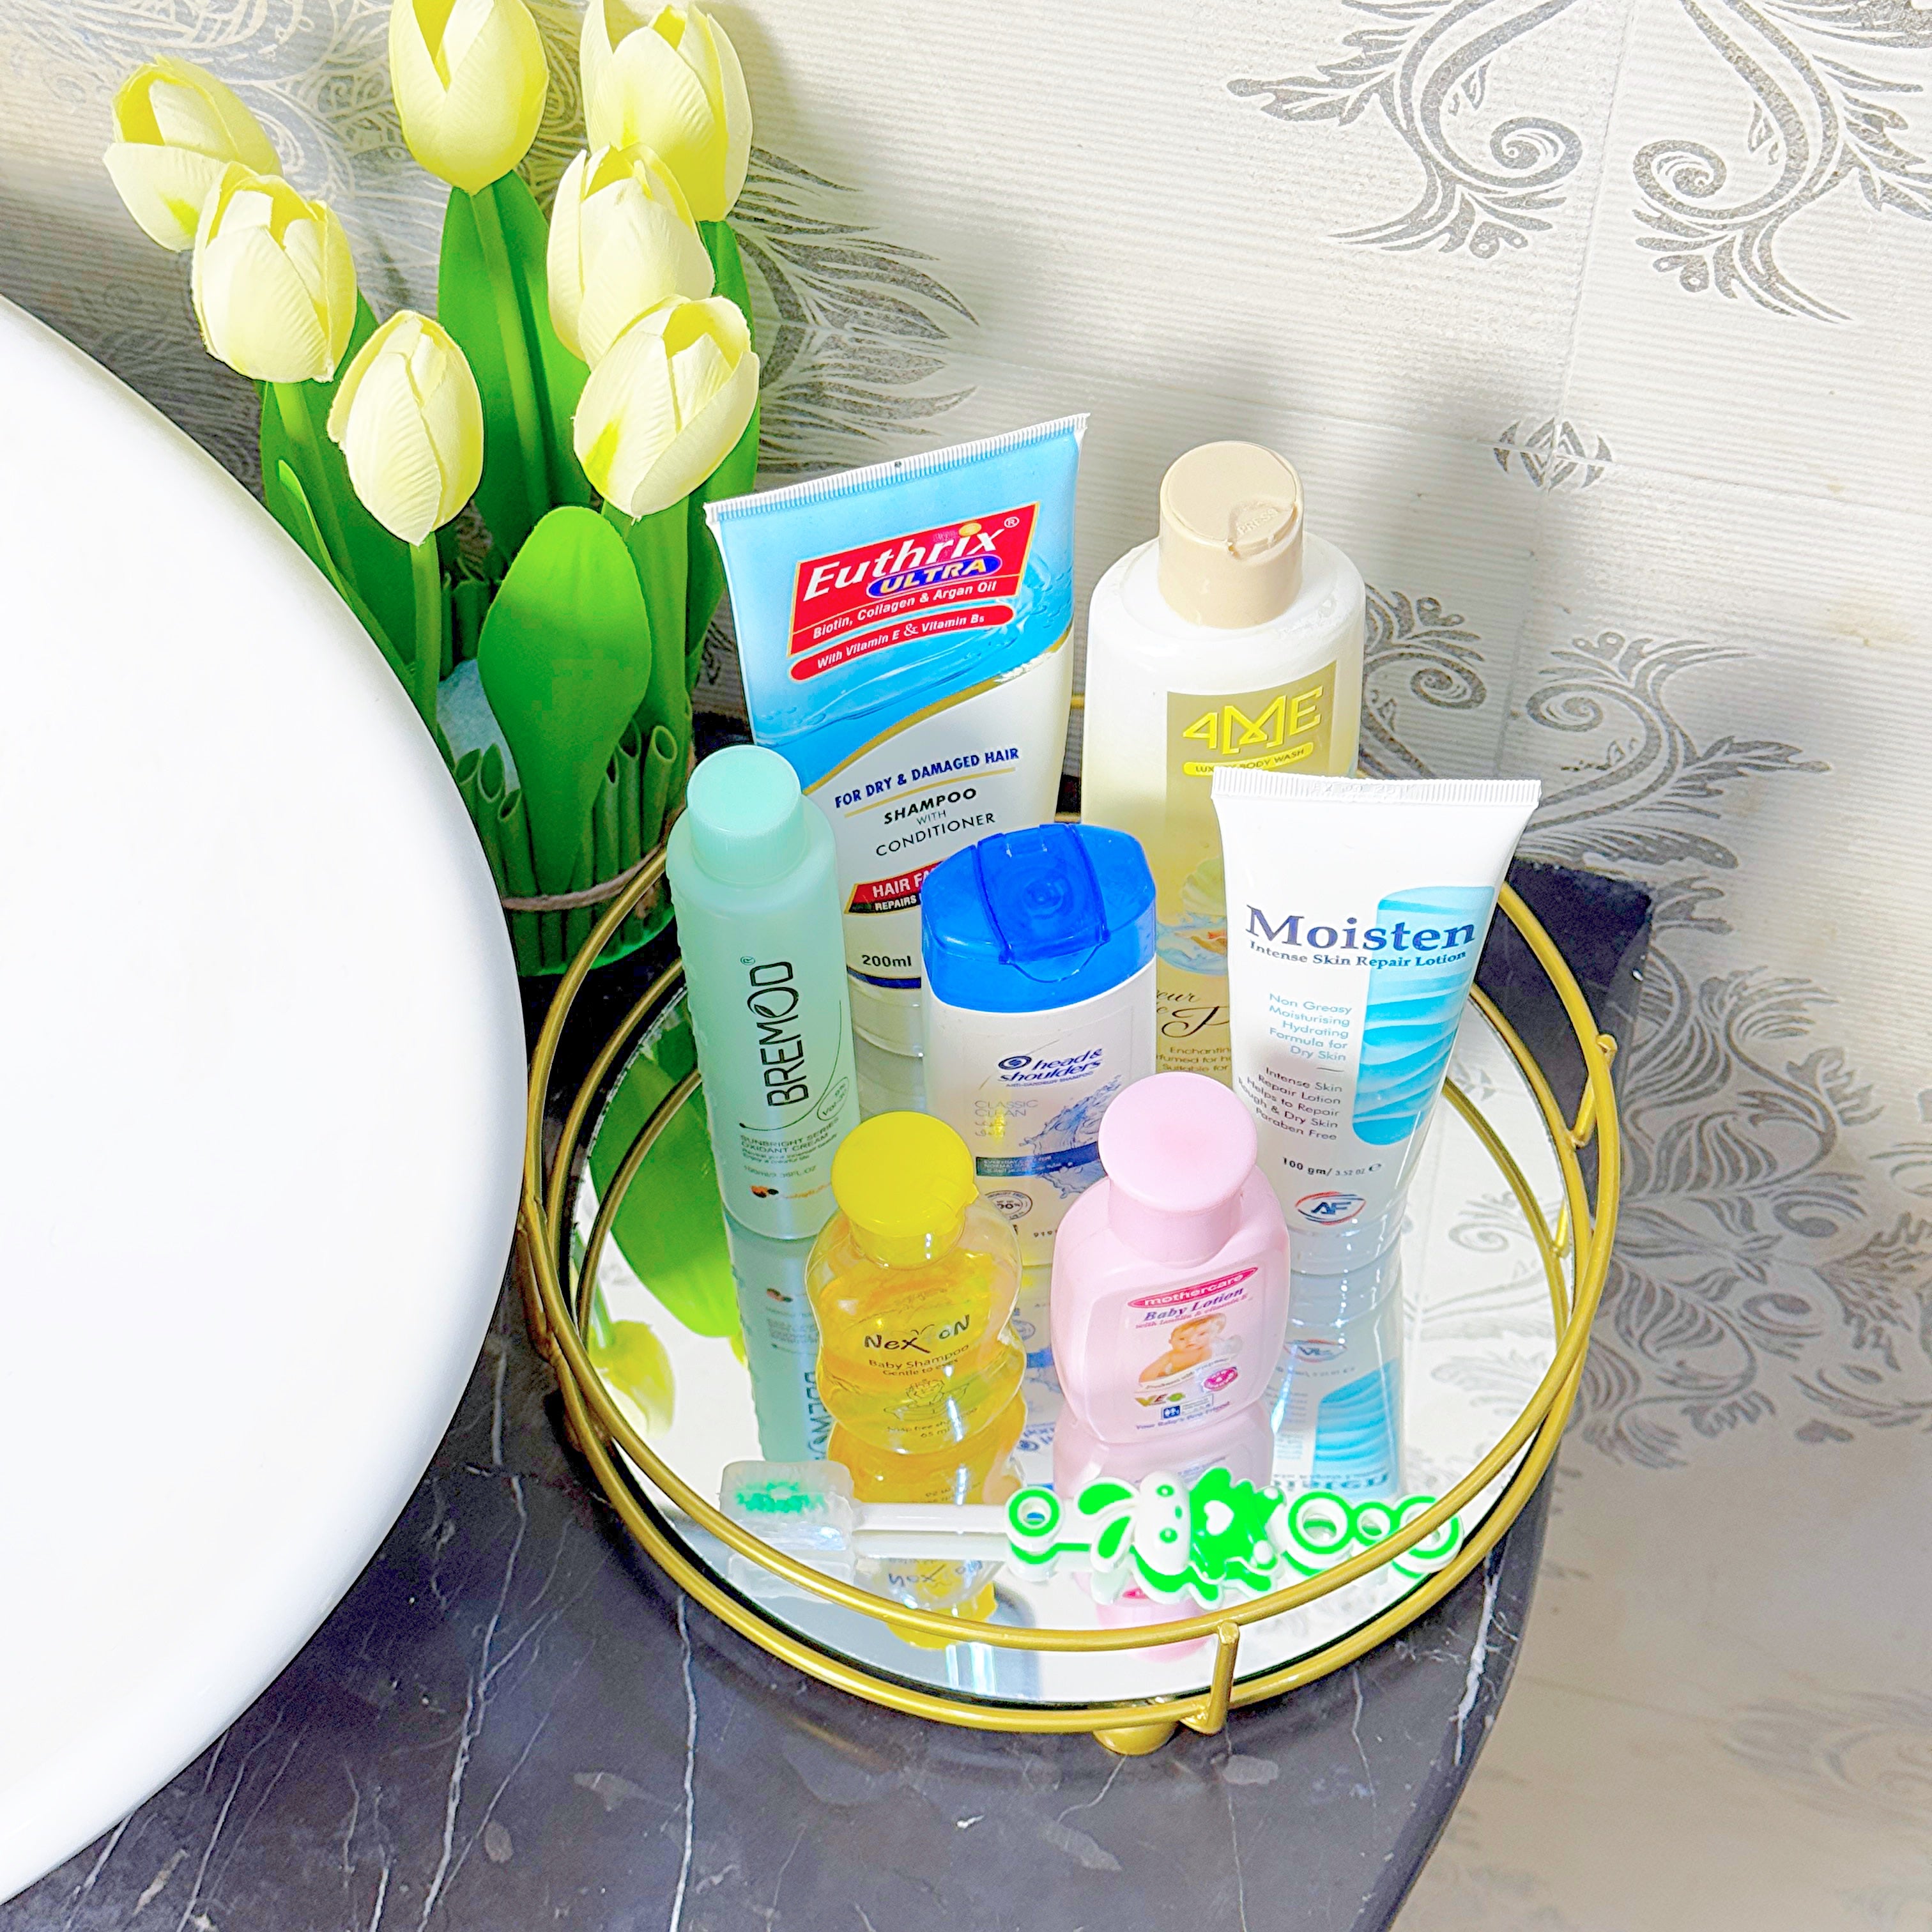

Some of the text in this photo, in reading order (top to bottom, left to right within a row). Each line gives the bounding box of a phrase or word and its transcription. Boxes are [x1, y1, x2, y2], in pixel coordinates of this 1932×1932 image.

[803, 523, 1004, 602] Euthrix
[879, 558, 987, 594] ULTRA
[813, 581, 997, 640] Biotin, Collagen & Argan Oil
[816, 652, 843, 670] With
[845, 633, 889, 656] Vitamin
[892, 630, 900, 640] E
[903, 624, 919, 638] &
[922, 617, 967, 633] Vitamin
[1183, 685, 1324, 755] 4ME
[1239, 758, 1271, 769] BODY
[1274, 748, 1304, 763] WASH
[834, 747, 1020, 809] FOR DRY & DAMAGED HAIR
[884, 788, 977, 825] SHAMPOO
[916, 809, 947, 825] WITH
[876, 813, 996, 856] CONDITIONER
[872, 877, 911, 898] HAIR
[875, 894, 917, 911] REPAIRS
[1245, 904, 1475, 951] Moisten
[862, 954, 912, 967] 200ml
[1250, 940, 1466, 970] Intense Skin Repair Lotion
[1269, 993, 1353, 1015] Non Greasy
[1269, 1005, 1350, 1027] Moisturising
[746, 961, 809, 1107] BREMOD
[1269, 1028, 1347, 1049] Formula for
[1282, 1020, 1349, 1039] Hydrating
[1156, 1054, 1200, 1063] fumed
[1170, 1046, 1231, 1055] Enchantin
[1290, 1046, 1346, 1061] Dry Skin
[998, 1059, 1103, 1082] shoulders
[1213, 1064, 1228, 1072] for
[1266, 1067, 1342, 1092] Intense Skin
[1247, 1077, 1340, 1117] Helps to Repair
[1258, 1074, 1340, 1105] Repair Lotion
[975, 1100, 1038, 1108] CLASSIC
[975, 1109, 1026, 1117] CLEAN
[1256, 1107, 1337, 1140] Paraben Free
[1271, 1106, 1280, 1115] &
[1284, 1110, 1306, 1124] Dry
[1311, 1118, 1338, 1128] Skin
[740, 1118, 839, 1147] SUNBRIGHT SERIES
[741, 1141, 788, 1153] OXIDANT
[792, 1133, 829, 1151] CREAM
[1283, 1156, 1333, 1176] 100 gm/
[1311, 1201, 1351, 1215] AF
[1144, 1274, 1244, 1306] mothercare
[1144, 1287, 1244, 1322] Baby Lotion
[868, 1344, 969, 1370] Baby Shampoo
